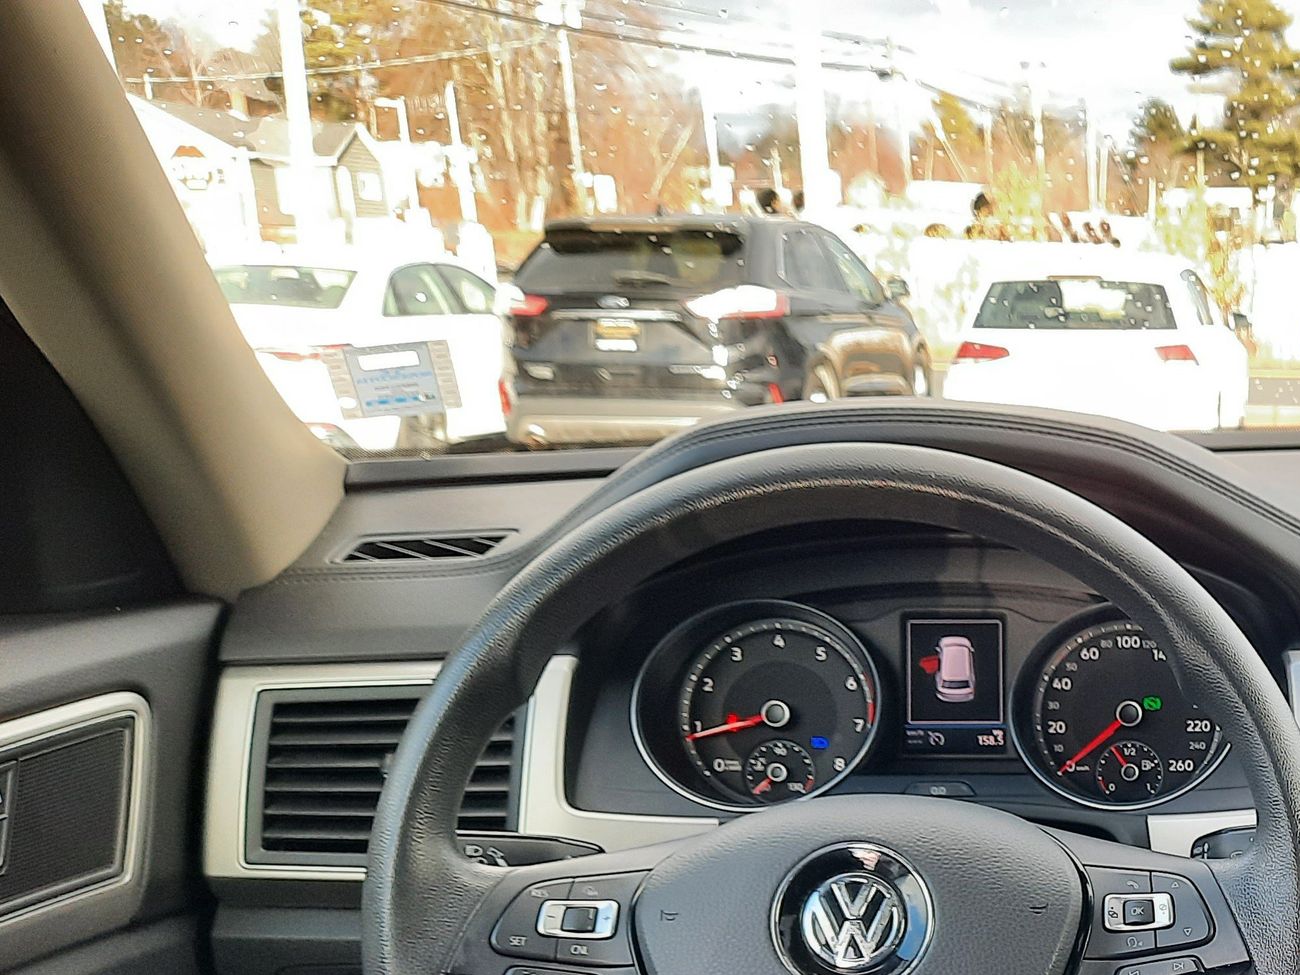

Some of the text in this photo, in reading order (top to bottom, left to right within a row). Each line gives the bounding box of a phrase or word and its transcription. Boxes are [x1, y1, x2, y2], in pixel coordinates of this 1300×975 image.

[773, 634, 785, 648] 4
[1116, 636, 1140, 649] 100
[731, 648, 743, 662] 3
[816, 647, 827, 661] 5
[1080, 648, 1099, 661] 60
[1153, 649, 1166, 661] 14
[1066, 663, 1078, 672] 50
[703, 679, 714, 692] 2
[846, 677, 858, 691] 6
[1052, 678, 1072, 691] 40
[1048, 701, 1060, 710] 30
[854, 719, 865, 732] 7
[1048, 721, 1066, 734] 20
[1186, 720, 1211, 733] 220
[713, 758, 725, 772] 0
[834, 757, 846, 772] 8
[1168, 760, 1193, 772] 260
[1131, 906, 1144, 916] OK
[509, 935, 527, 946] SET
